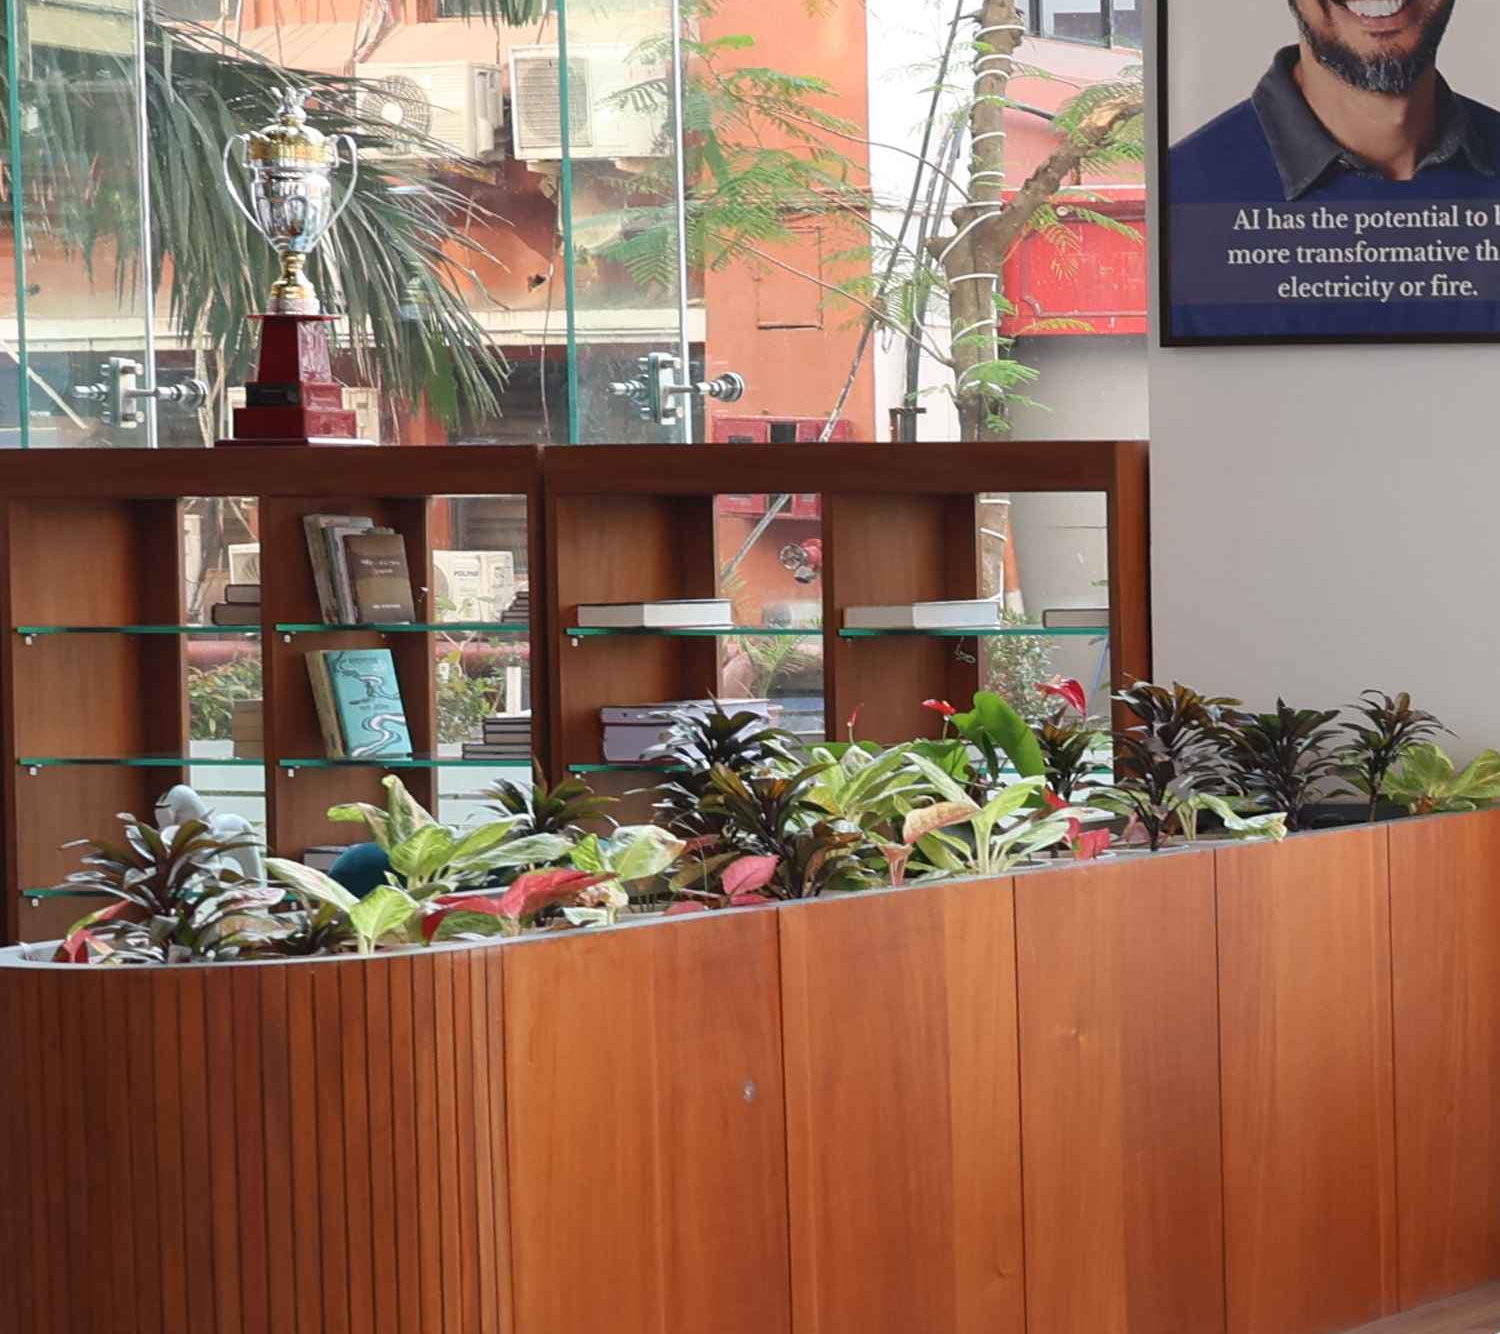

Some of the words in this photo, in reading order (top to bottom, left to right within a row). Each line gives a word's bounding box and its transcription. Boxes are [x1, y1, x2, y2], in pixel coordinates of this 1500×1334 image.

[1233, 208, 1260, 230] AI
[1266, 207, 1306, 230] has
[1311, 206, 1348, 229] the
[1354, 204, 1459, 235] potential
[1465, 208, 1489, 227] to
[1227, 246, 1291, 265] more
[1296, 239, 1470, 264] transformative
[1277, 275, 1395, 303] electricity
[1399, 279, 1426, 297] or
[1430, 273, 1478, 297] fire.
